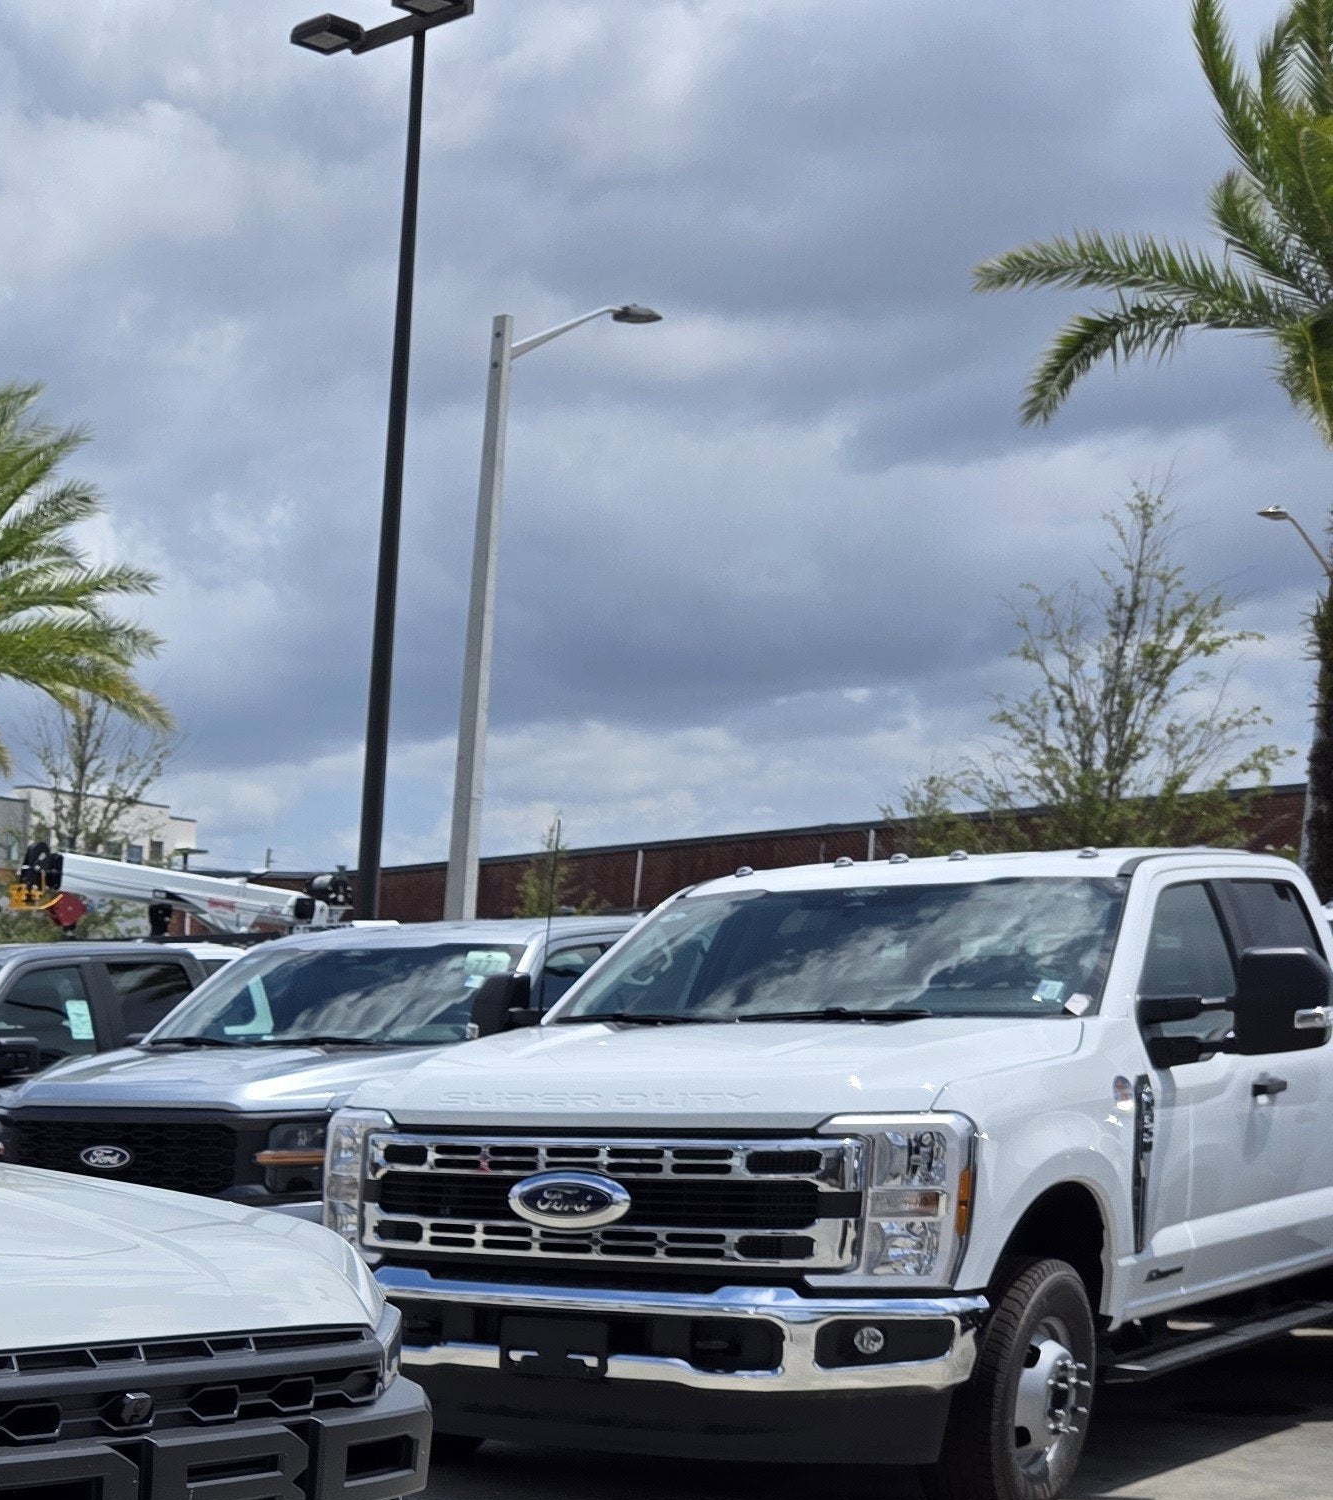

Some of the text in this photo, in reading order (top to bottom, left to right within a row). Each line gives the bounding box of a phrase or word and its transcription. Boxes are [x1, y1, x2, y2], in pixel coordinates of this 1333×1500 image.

[439, 1091, 761, 1108] SUPER DUTY
[89, 1149, 121, 1165] Ford
[536, 1188, 593, 1212] Ford
